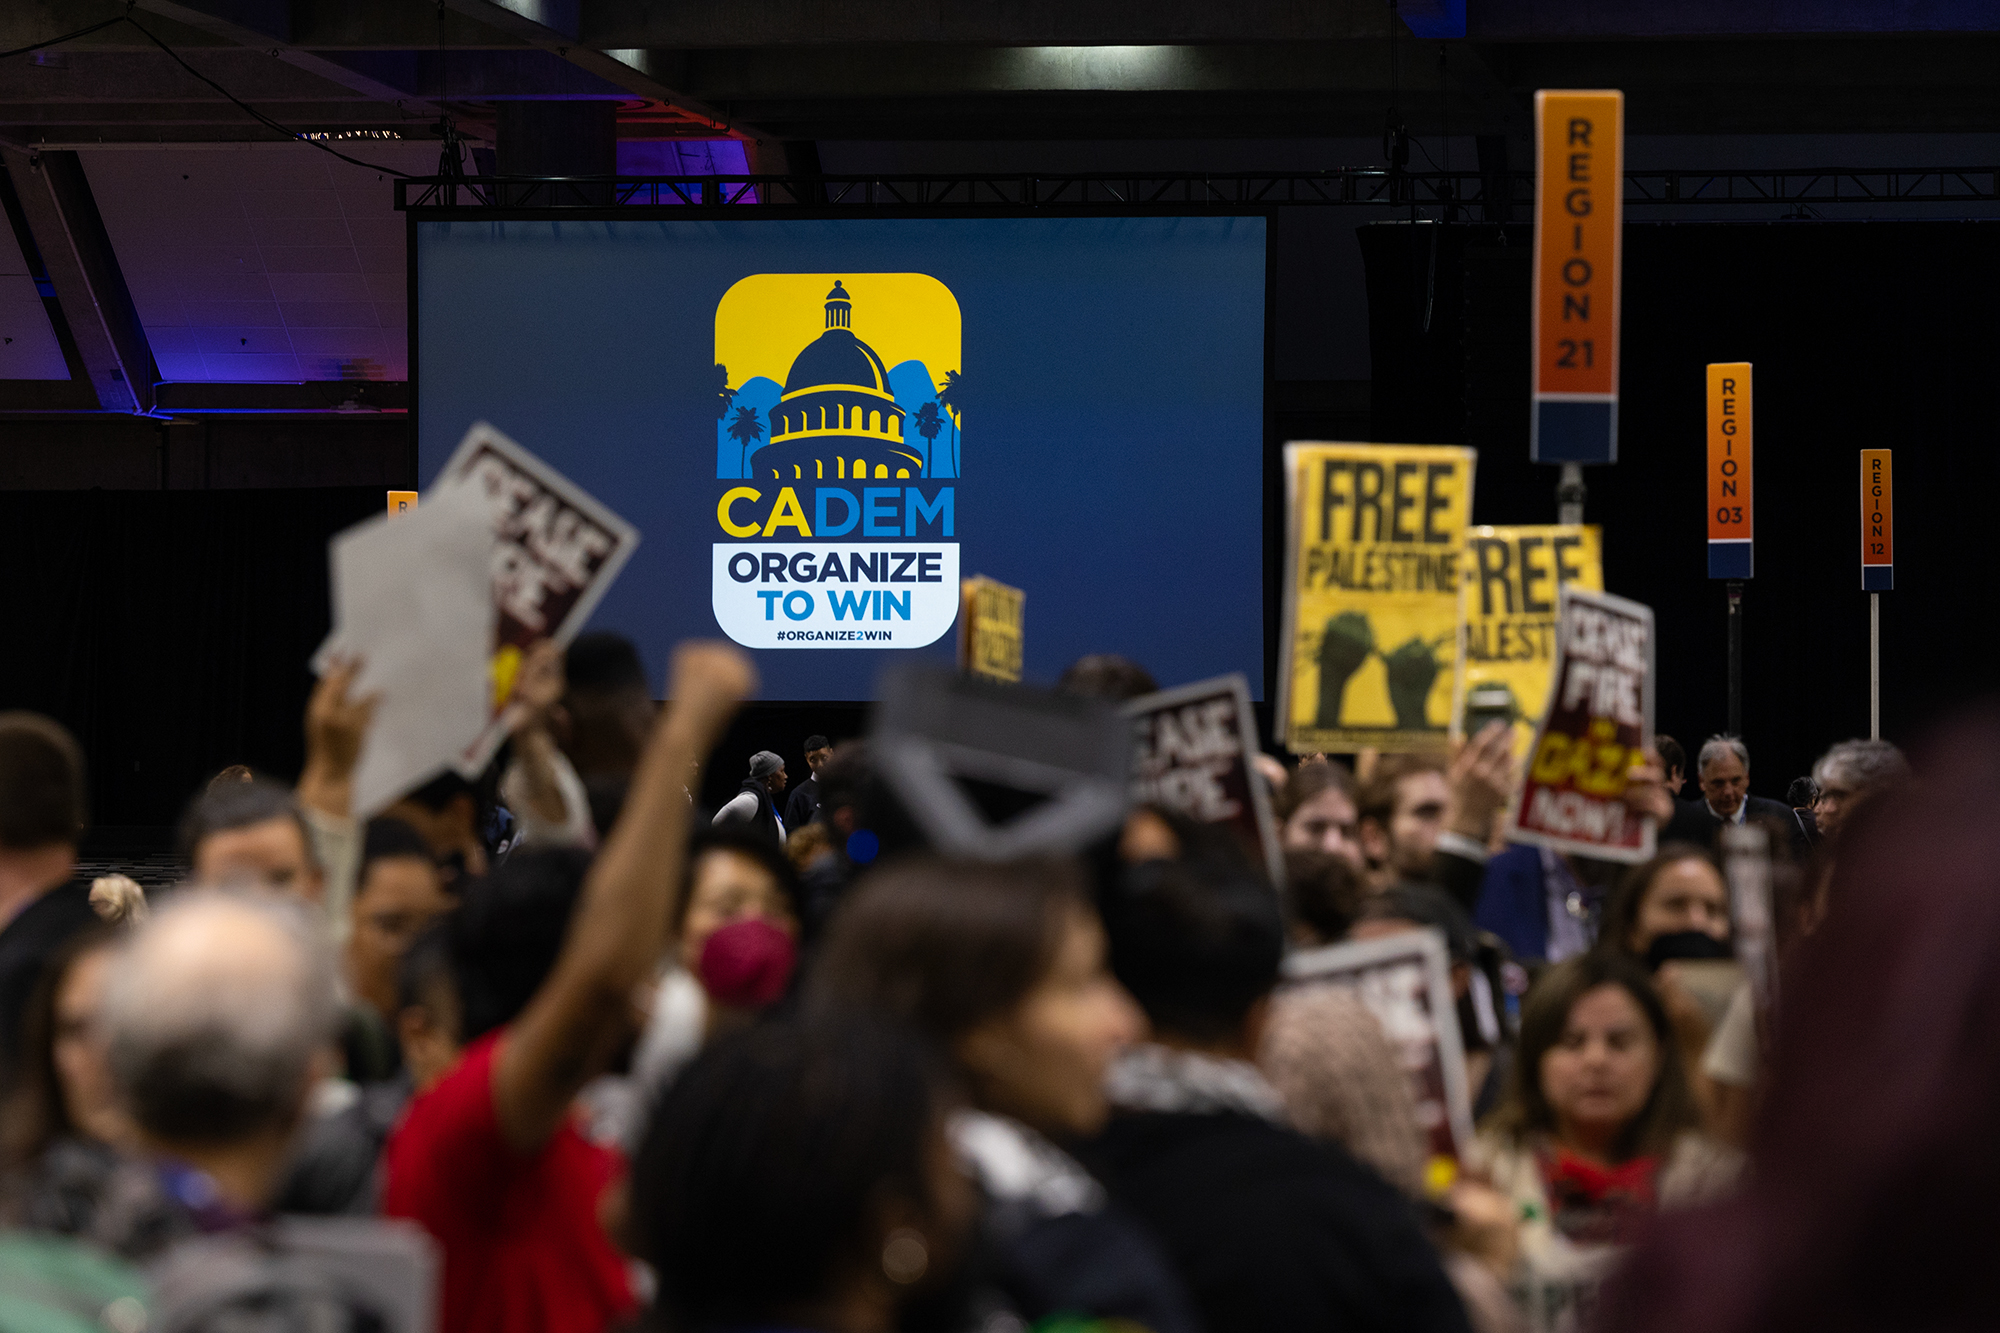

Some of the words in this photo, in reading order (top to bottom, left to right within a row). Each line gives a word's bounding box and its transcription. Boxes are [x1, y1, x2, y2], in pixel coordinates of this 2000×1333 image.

[1561, 118, 1593, 322] REGION
[1555, 339, 1595, 369] 21
[1720, 378, 1739, 498] REGION
[716, 486, 956, 538] CADEM
[1320, 459, 1456, 545] FREE
[1716, 506, 1744, 525] 03
[1871, 458, 1883, 538] REGION
[727, 551, 943, 584] ORGANIZE
[1870, 542, 1885, 556] 12
[1304, 547, 1459, 592] PALESTINE
[756, 589, 816, 622] TO
[826, 589, 912, 621] WIN
[776, 630, 893, 642] #ORGANIZE2WIN
